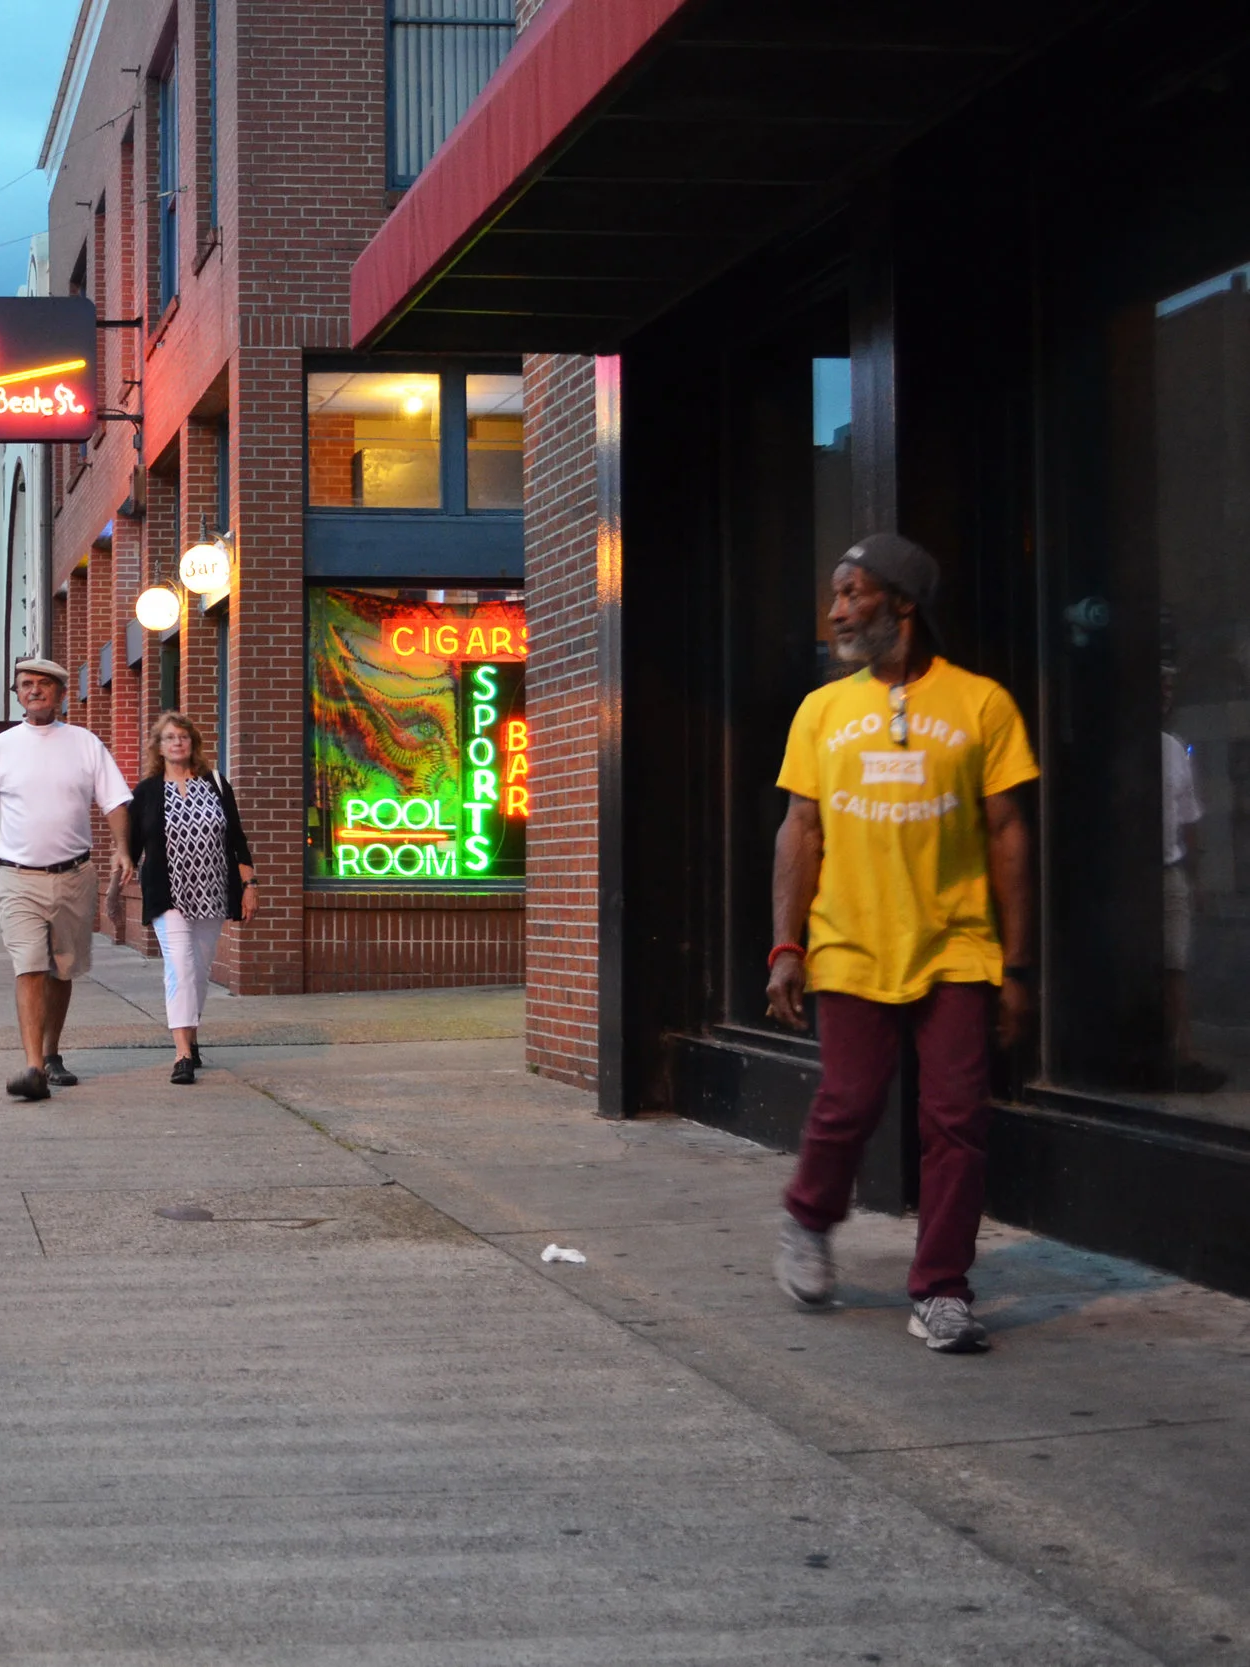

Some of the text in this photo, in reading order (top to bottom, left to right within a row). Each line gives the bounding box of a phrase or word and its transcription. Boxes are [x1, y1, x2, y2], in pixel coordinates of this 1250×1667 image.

[185, 561, 218, 577] Bar
[898, 712, 966, 748] URF
[462, 665, 498, 871] SPORTS
[507, 720, 530, 817] BAR
[345, 798, 457, 830] POOL
[829, 789, 960, 824] CALIFORNIA
[338, 843, 457, 876] ROOM
